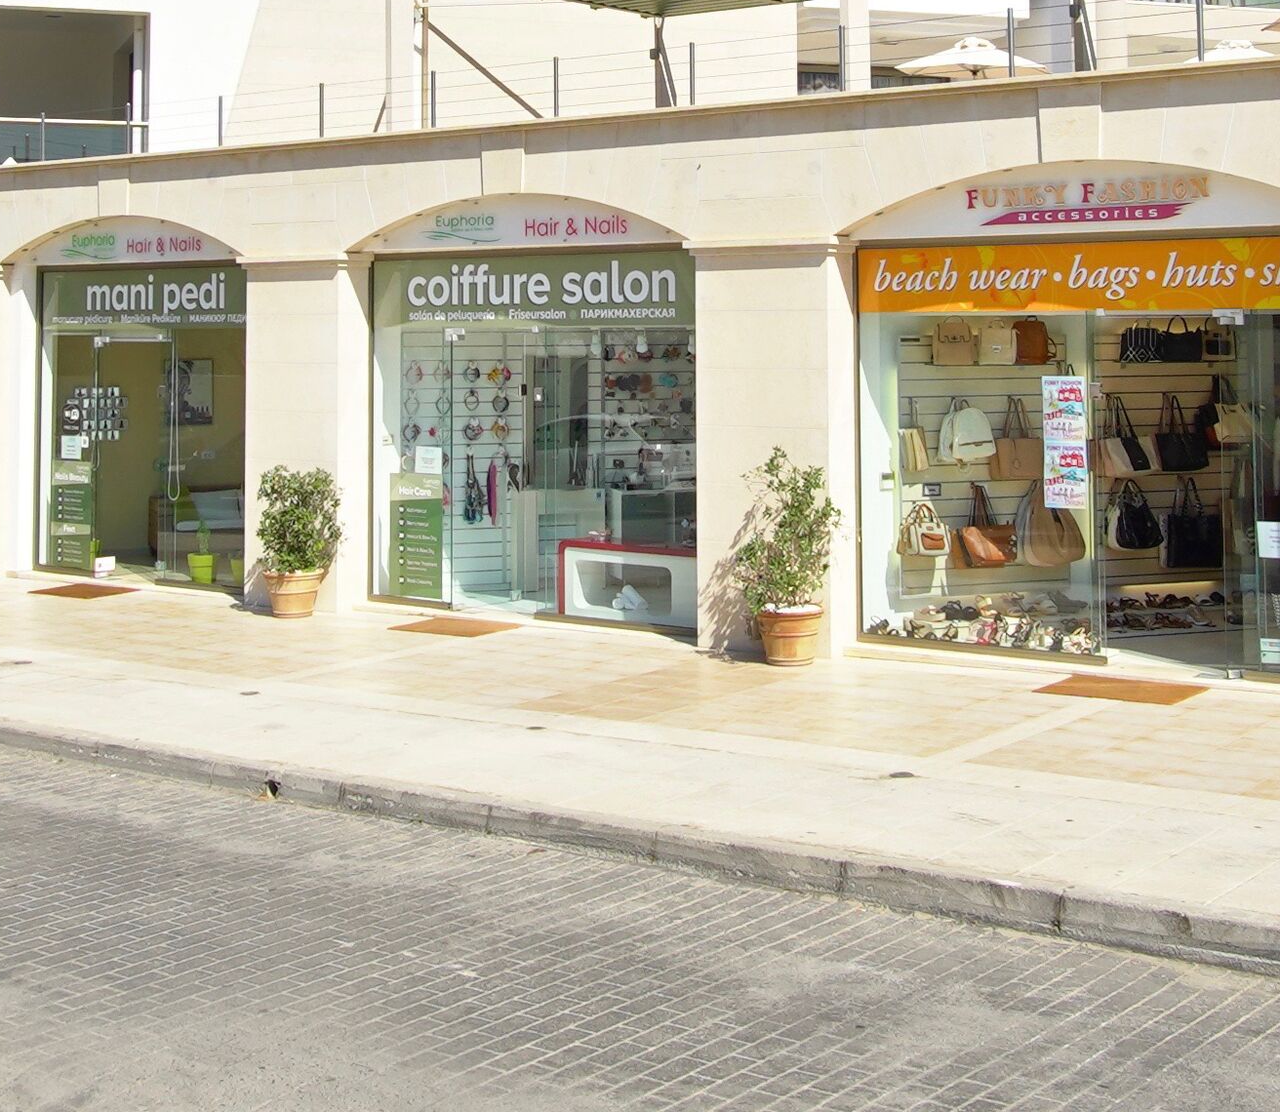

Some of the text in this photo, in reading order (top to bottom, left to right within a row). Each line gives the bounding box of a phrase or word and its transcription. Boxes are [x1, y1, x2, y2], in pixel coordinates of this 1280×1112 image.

[965, 174, 1211, 210] FUNKY FASHION
[435, 214, 494, 228] Euphoria
[1018, 206, 1159, 222] accessories
[524, 215, 628, 236] Hair & Nails
[72, 233, 115, 249] Euphoria
[126, 236, 203, 254] Hair & Nails
[407, 260, 676, 307] coiffure salon
[874, 257, 959, 293] beach
[969, 267, 1047, 293] wear
[1068, 253, 1140, 300] bags
[1161, 251, 1238, 288] huts
[86, 272, 226, 319] mani pedi
[509, 308, 566, 320] Friseursalon
[580, 308, 676, 319] ПАРИКМАХЕРСКАЯ
